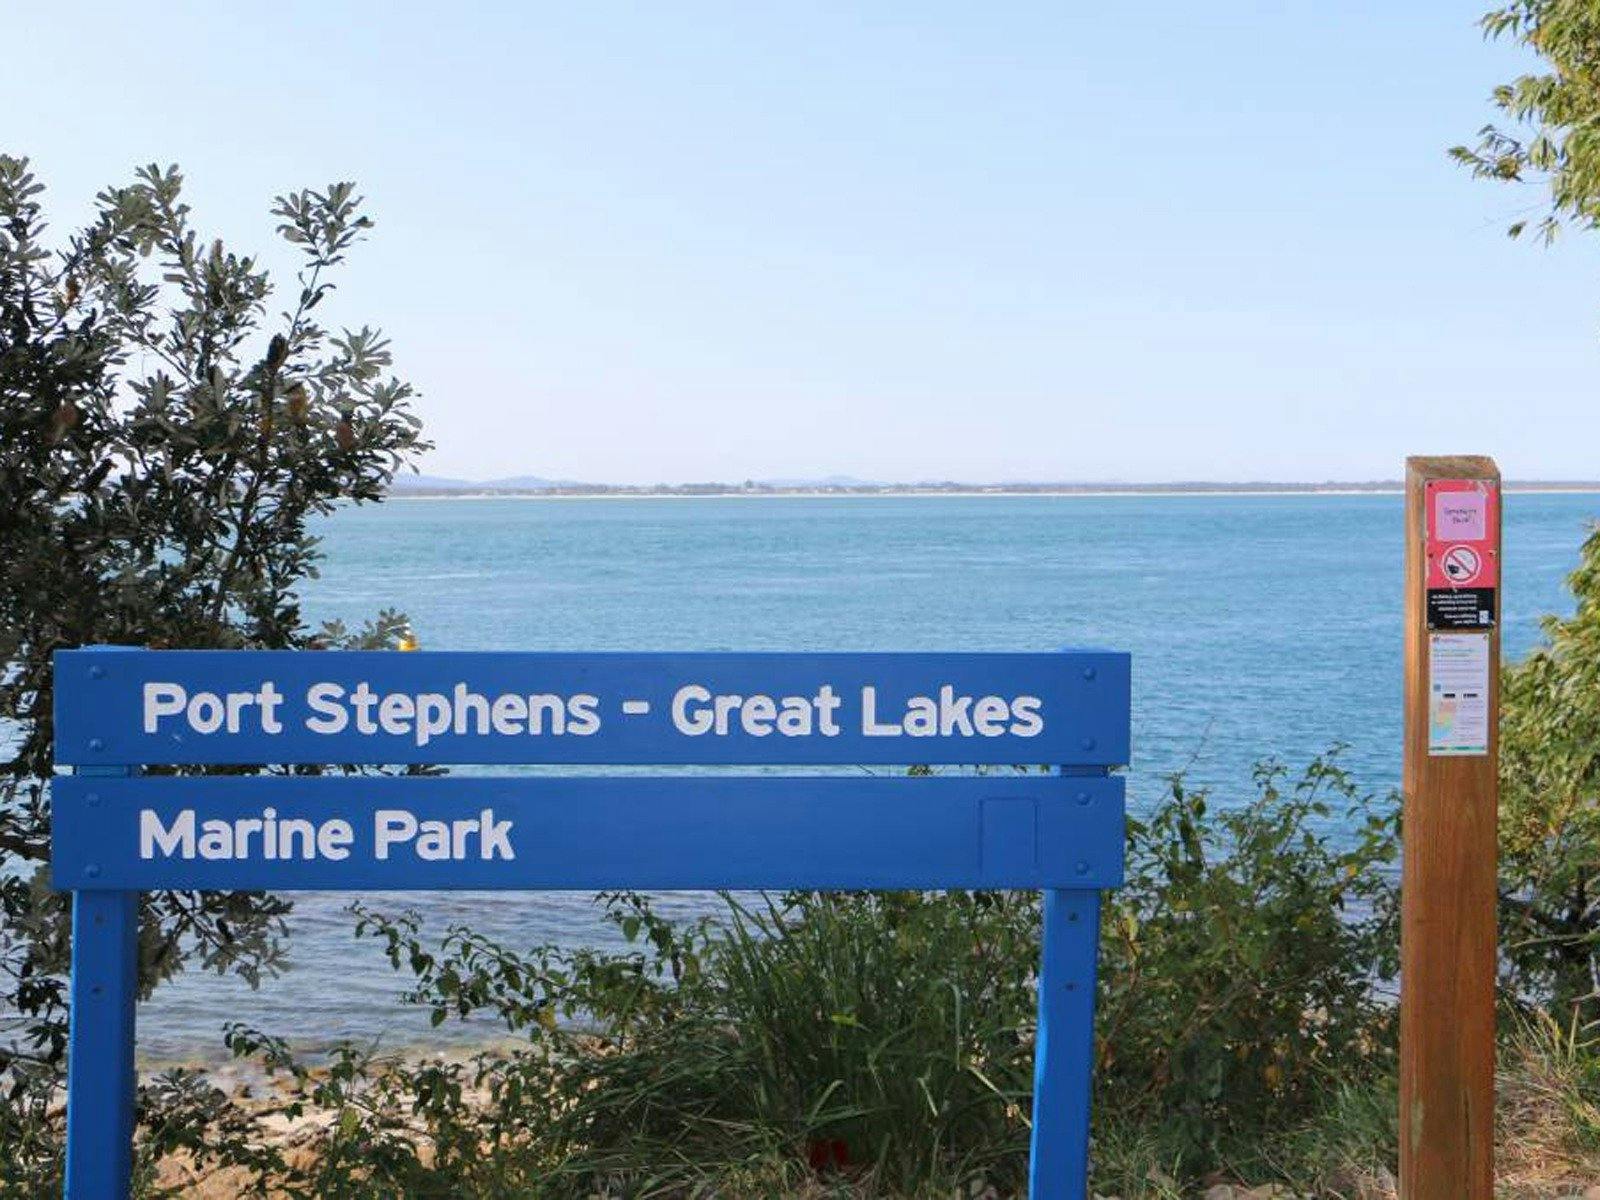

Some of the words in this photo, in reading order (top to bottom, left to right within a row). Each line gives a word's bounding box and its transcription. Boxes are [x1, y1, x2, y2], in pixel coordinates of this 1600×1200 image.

[143, 682, 283, 734] Port
[305, 682, 601, 746] Stephens
[622, 701, 649, 714] -
[671, 685, 841, 737] Great
[861, 685, 1044, 737] Lakes
[139, 807, 354, 861] Marine
[374, 808, 515, 861] Park
